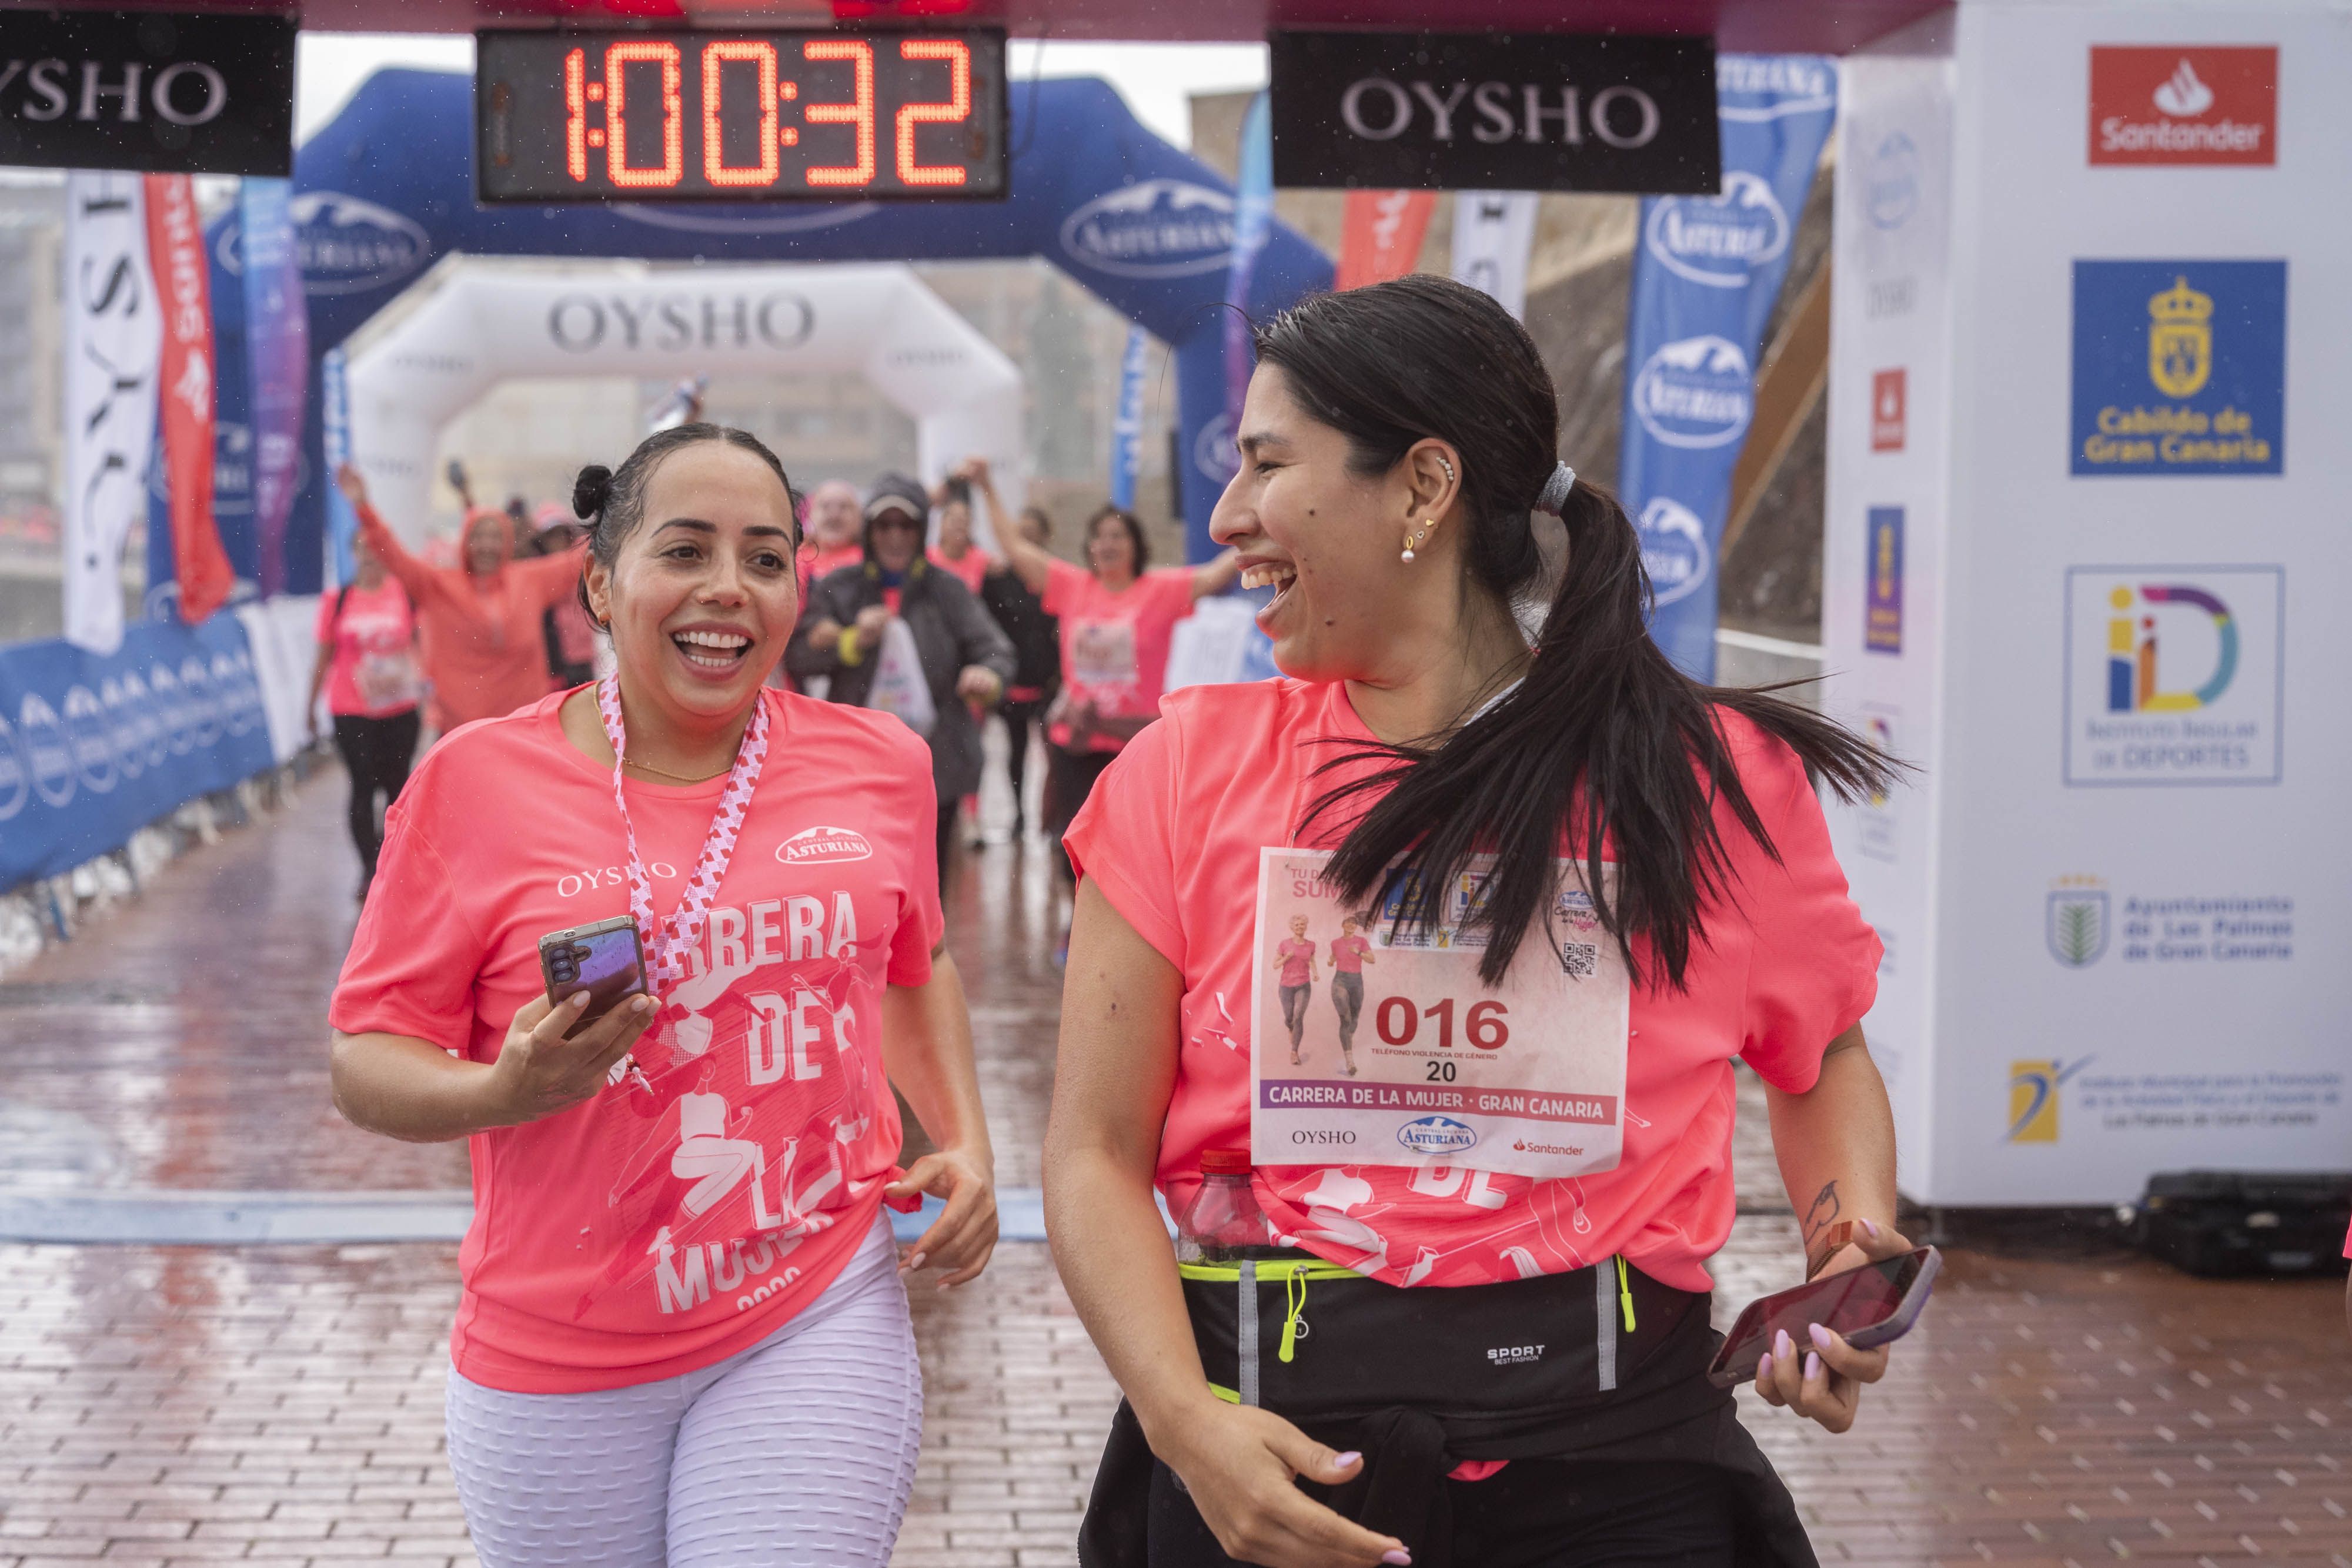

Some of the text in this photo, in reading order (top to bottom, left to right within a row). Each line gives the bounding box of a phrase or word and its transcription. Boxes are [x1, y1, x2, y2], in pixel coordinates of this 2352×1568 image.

[0, 59, 228, 125] YSHO
[565, 41, 971, 188] 1:00:32
[1339, 76, 1661, 149] OYSHO
[2100, 117, 2264, 152] Santander
[547, 292, 816, 353] OYSHO
[2097, 406, 2251, 434] Cabildo de
[2085, 433, 2270, 463] Gran Canaria
[2123, 744, 2250, 768] DEPORTES
[787, 841, 868, 861] ASTURIANA
[2125, 895, 2292, 917] Ayuntamiento
[2125, 918, 2292, 937] de Las Palmas
[2125, 942, 2292, 961] de Gran Canaria
[1376, 996, 1509, 1050] 016
[743, 986, 826, 1086] DE
[1371, 1048, 1411, 1057] TELÉFONO
[1411, 1050, 1452, 1058] VIOLENCIA
[1465, 1051, 1498, 1060] GÉNERO
[1426, 1061, 1456, 1082] 20
[1269, 1086, 1604, 1119] CARRERA DE LA MUJER GRAN CANARIA
[1292, 1130, 1356, 1145] OYSHO
[1404, 1128, 1471, 1145] ASTURIANA
[1527, 1142, 1584, 1156] Santander
[1487, 1345, 1545, 1359] SPORT
[1512, 1355, 1539, 1363] FASHION
